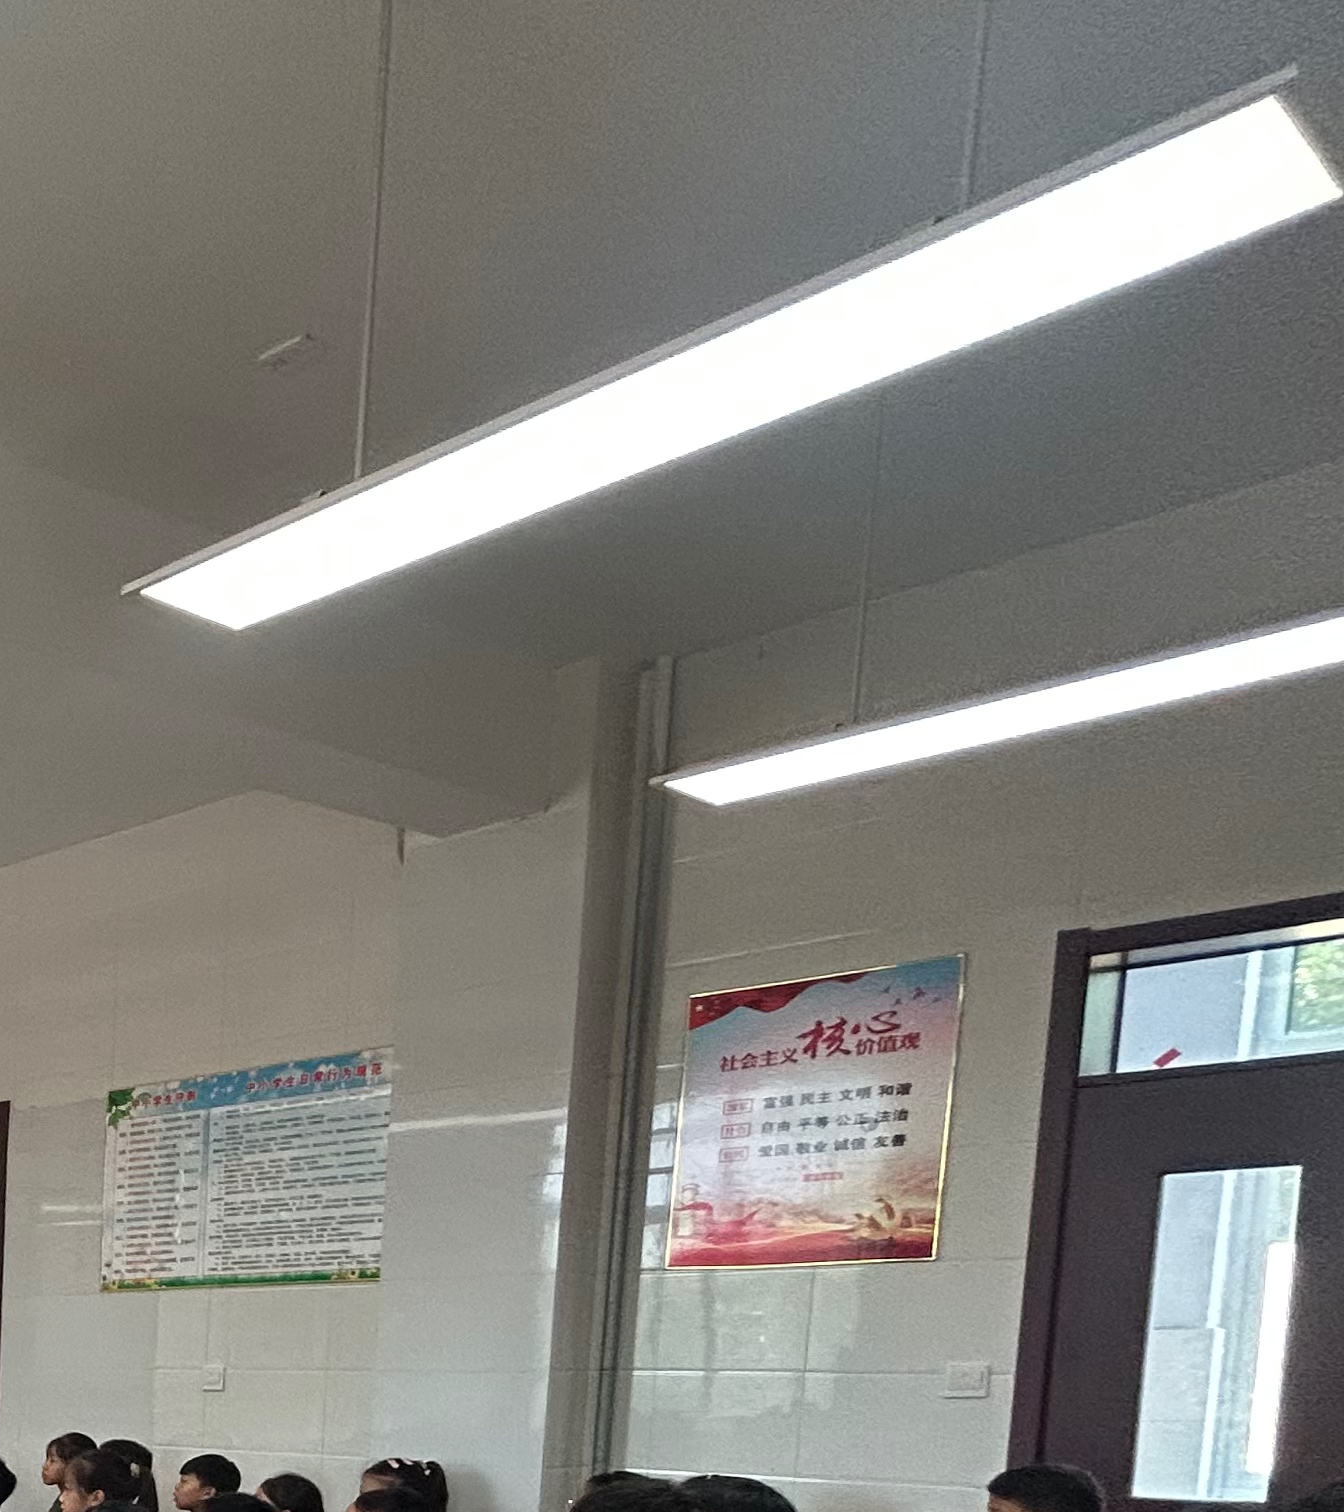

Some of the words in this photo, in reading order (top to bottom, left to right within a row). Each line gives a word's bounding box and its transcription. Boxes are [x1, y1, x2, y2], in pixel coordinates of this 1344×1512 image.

[720, 1010, 921, 1072] 社会主义核心价值观
